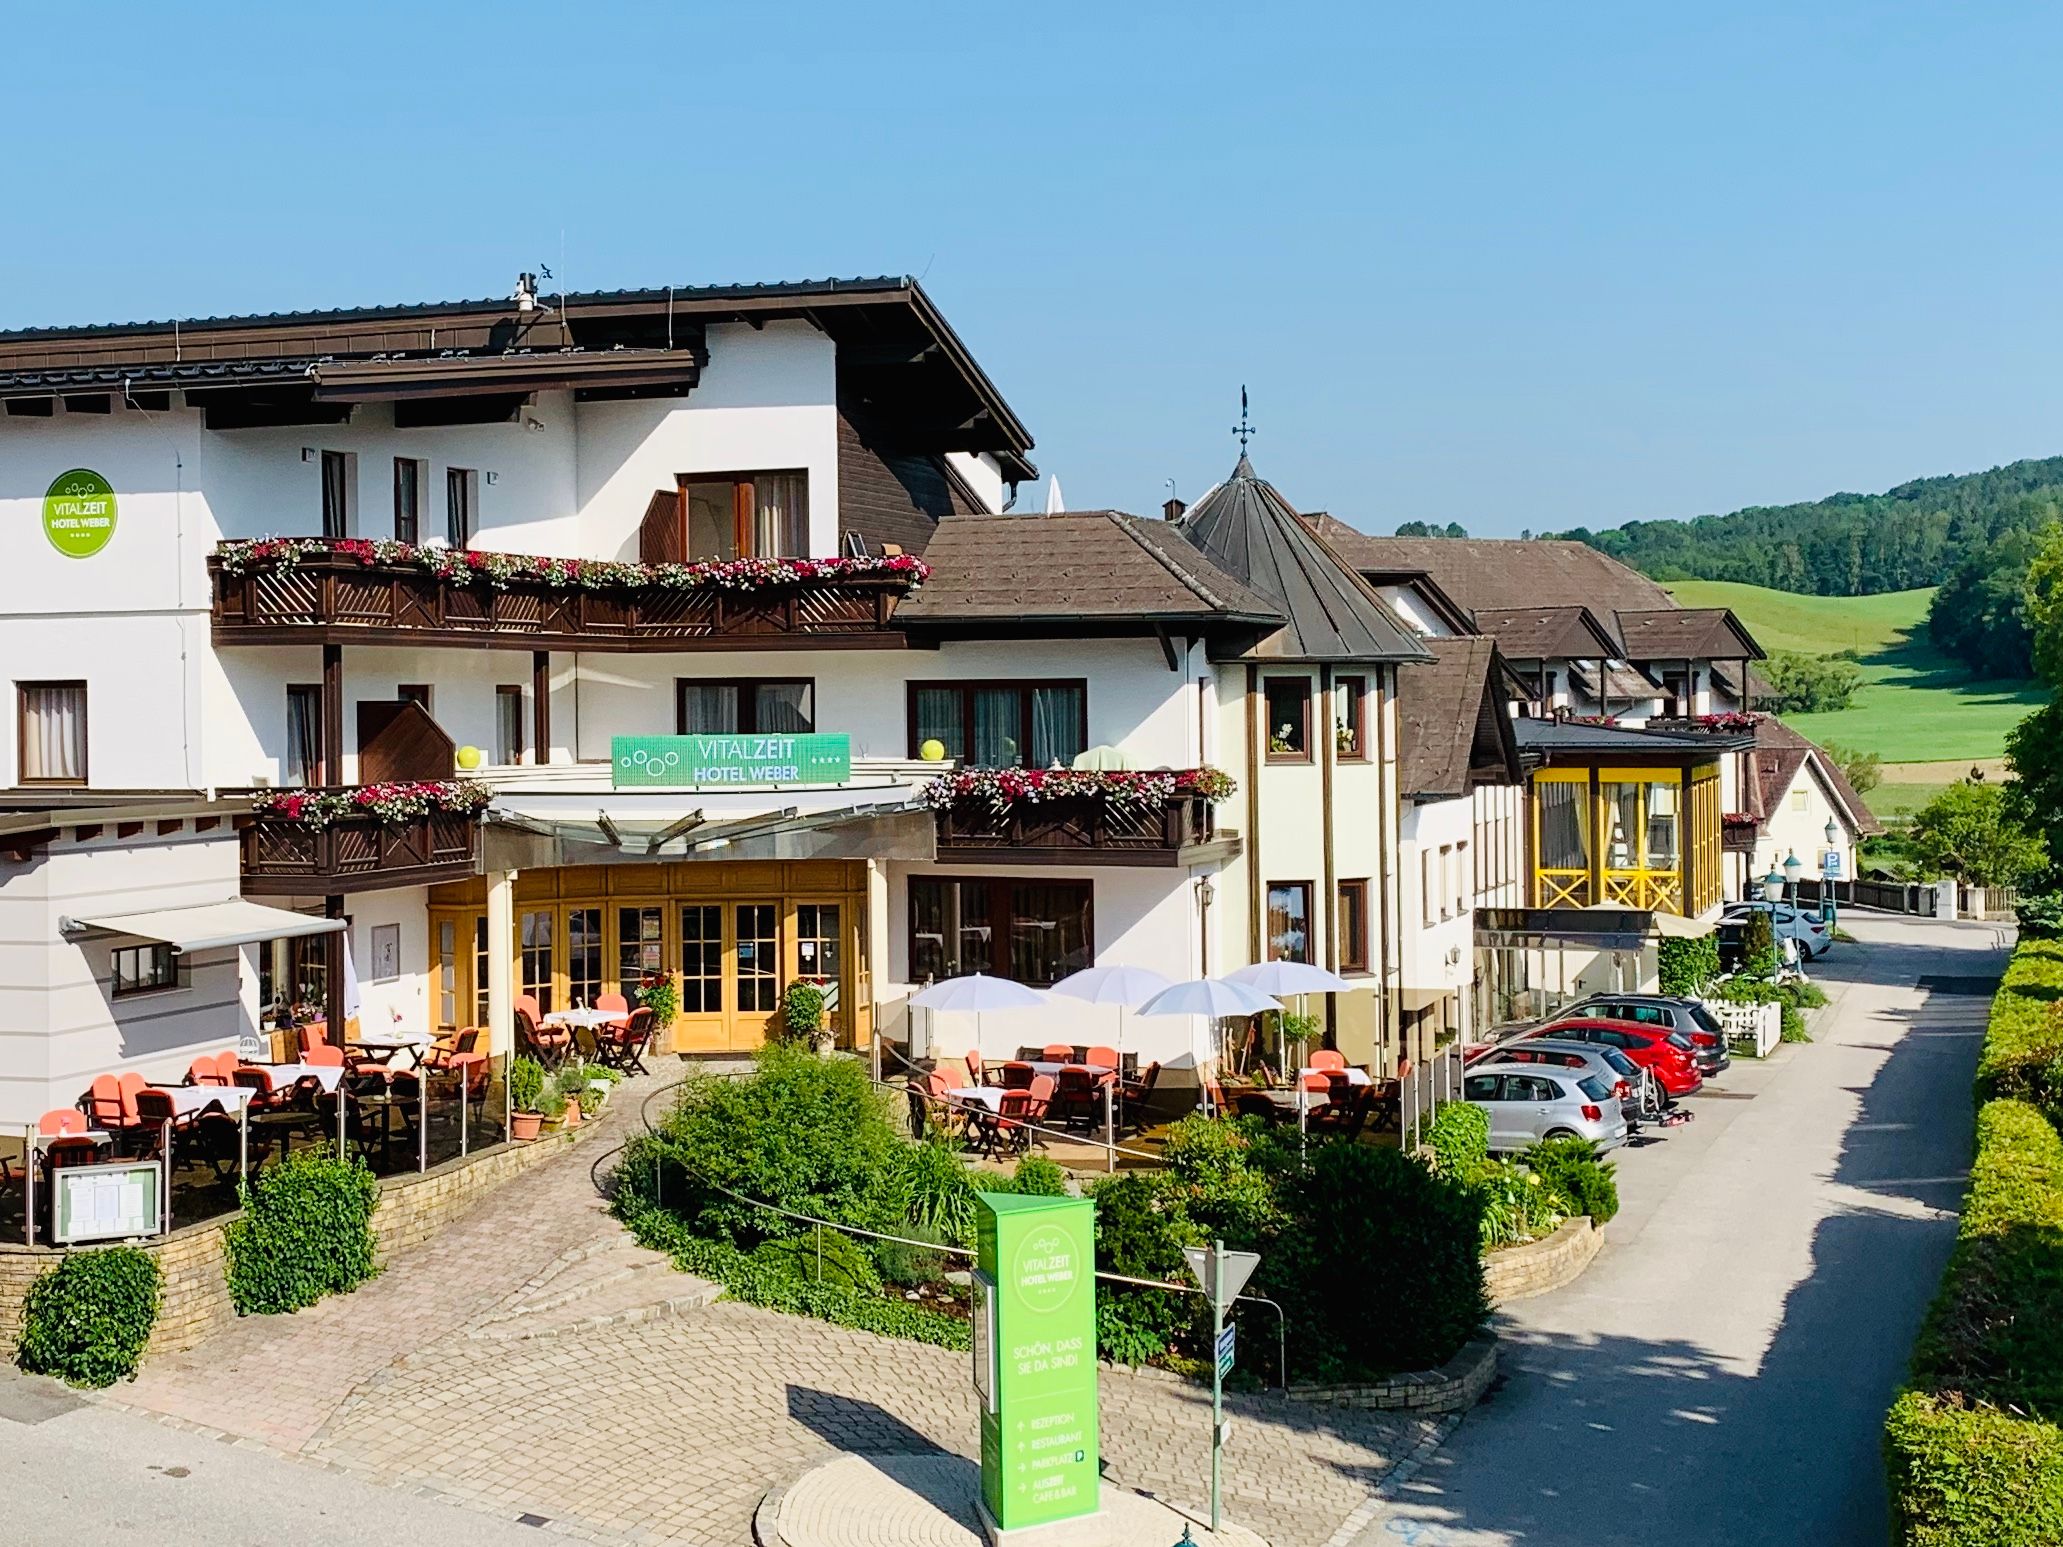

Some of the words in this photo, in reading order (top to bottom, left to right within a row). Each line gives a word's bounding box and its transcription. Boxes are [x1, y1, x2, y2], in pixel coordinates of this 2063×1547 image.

[53, 501, 107, 516] VITALZEIT
[51, 518, 80, 529] HOTEL
[80, 517, 110, 528] WEBER
[698, 738, 796, 760] VITALZEIT
[694, 767, 747, 782] HOTEL
[748, 765, 800, 781] WEBER
[1827, 853, 1838, 867] P
[1023, 1254, 1071, 1273] VITALZEIT
[1021, 1273, 1047, 1288] HOTEL
[1047, 1270, 1073, 1283] WEBER
[1056, 1337, 1082, 1353] DASS
[1017, 1361, 1032, 1376] SIE
[1034, 1359, 1048, 1373] DA
[1031, 1412, 1075, 1430] REZEPTION
[1031, 1430, 1083, 1450] RESTAURANT
[1031, 1452, 1074, 1471] PARKPLATZ
